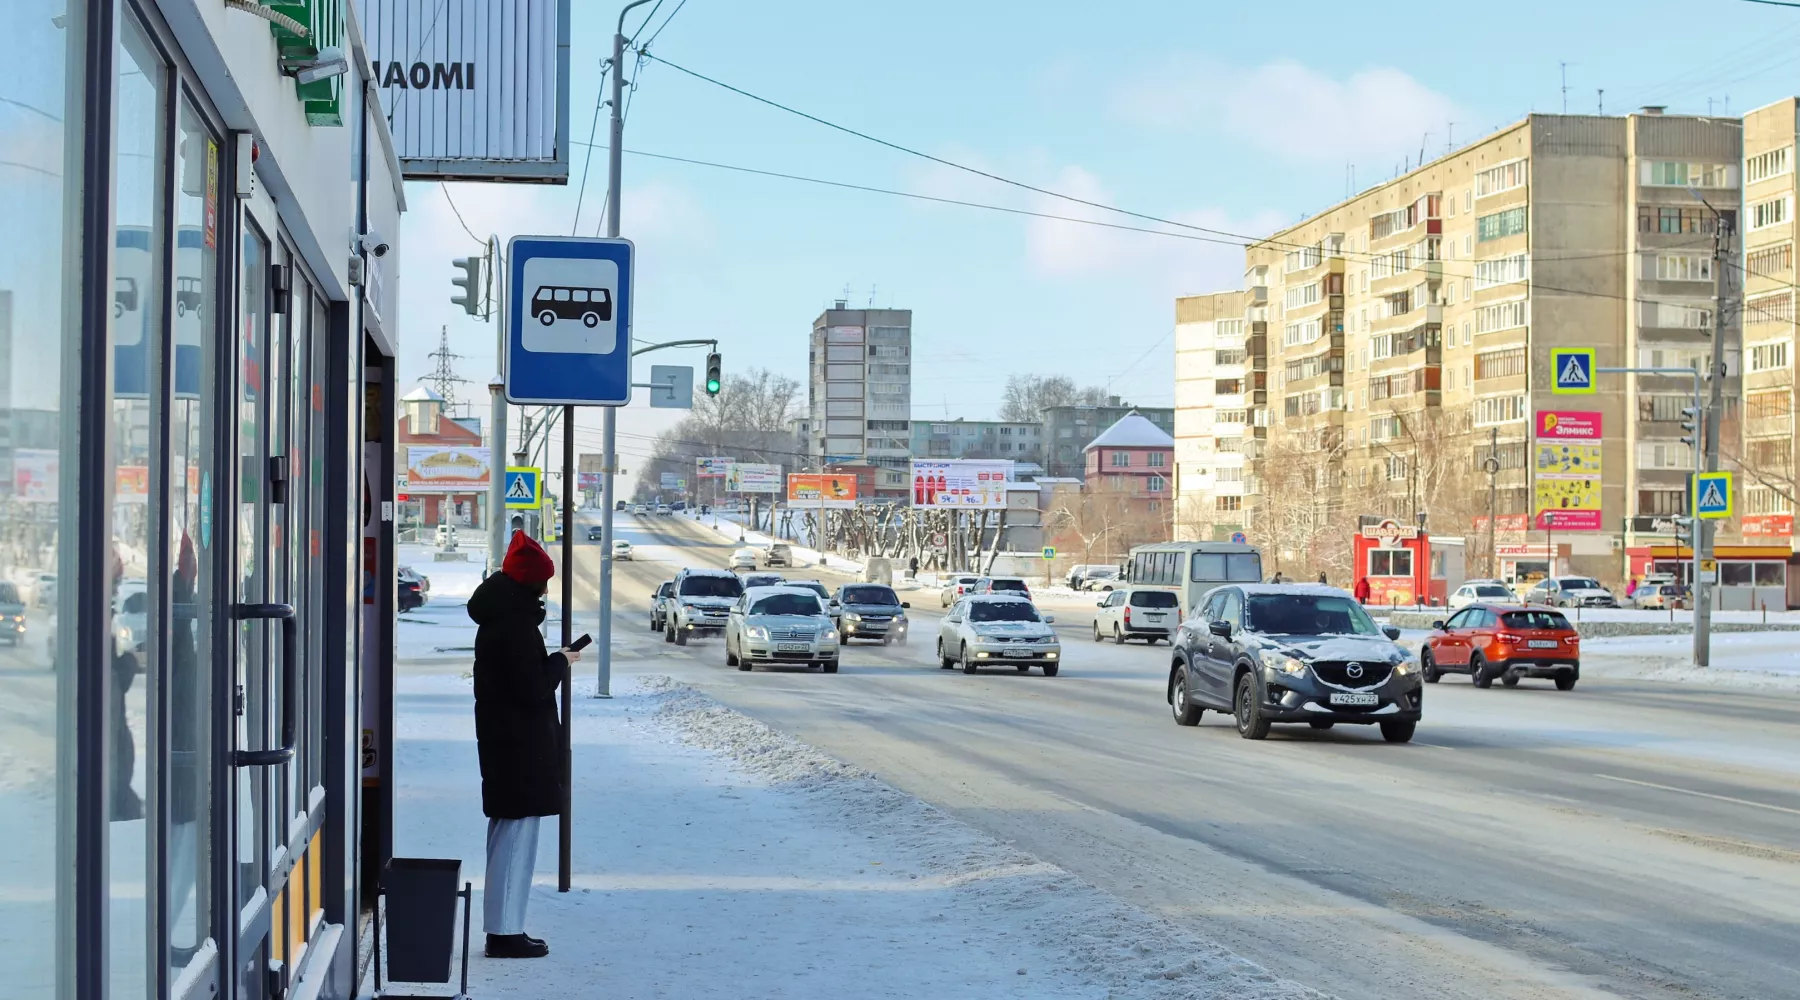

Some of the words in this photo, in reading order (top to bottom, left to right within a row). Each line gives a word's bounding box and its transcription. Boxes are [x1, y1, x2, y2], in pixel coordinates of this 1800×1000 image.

[1556, 425, 1594, 435] Элмикс
[1365, 528, 1414, 537] ШАВЕРМА
[1500, 544, 1528, 554] хлеб
